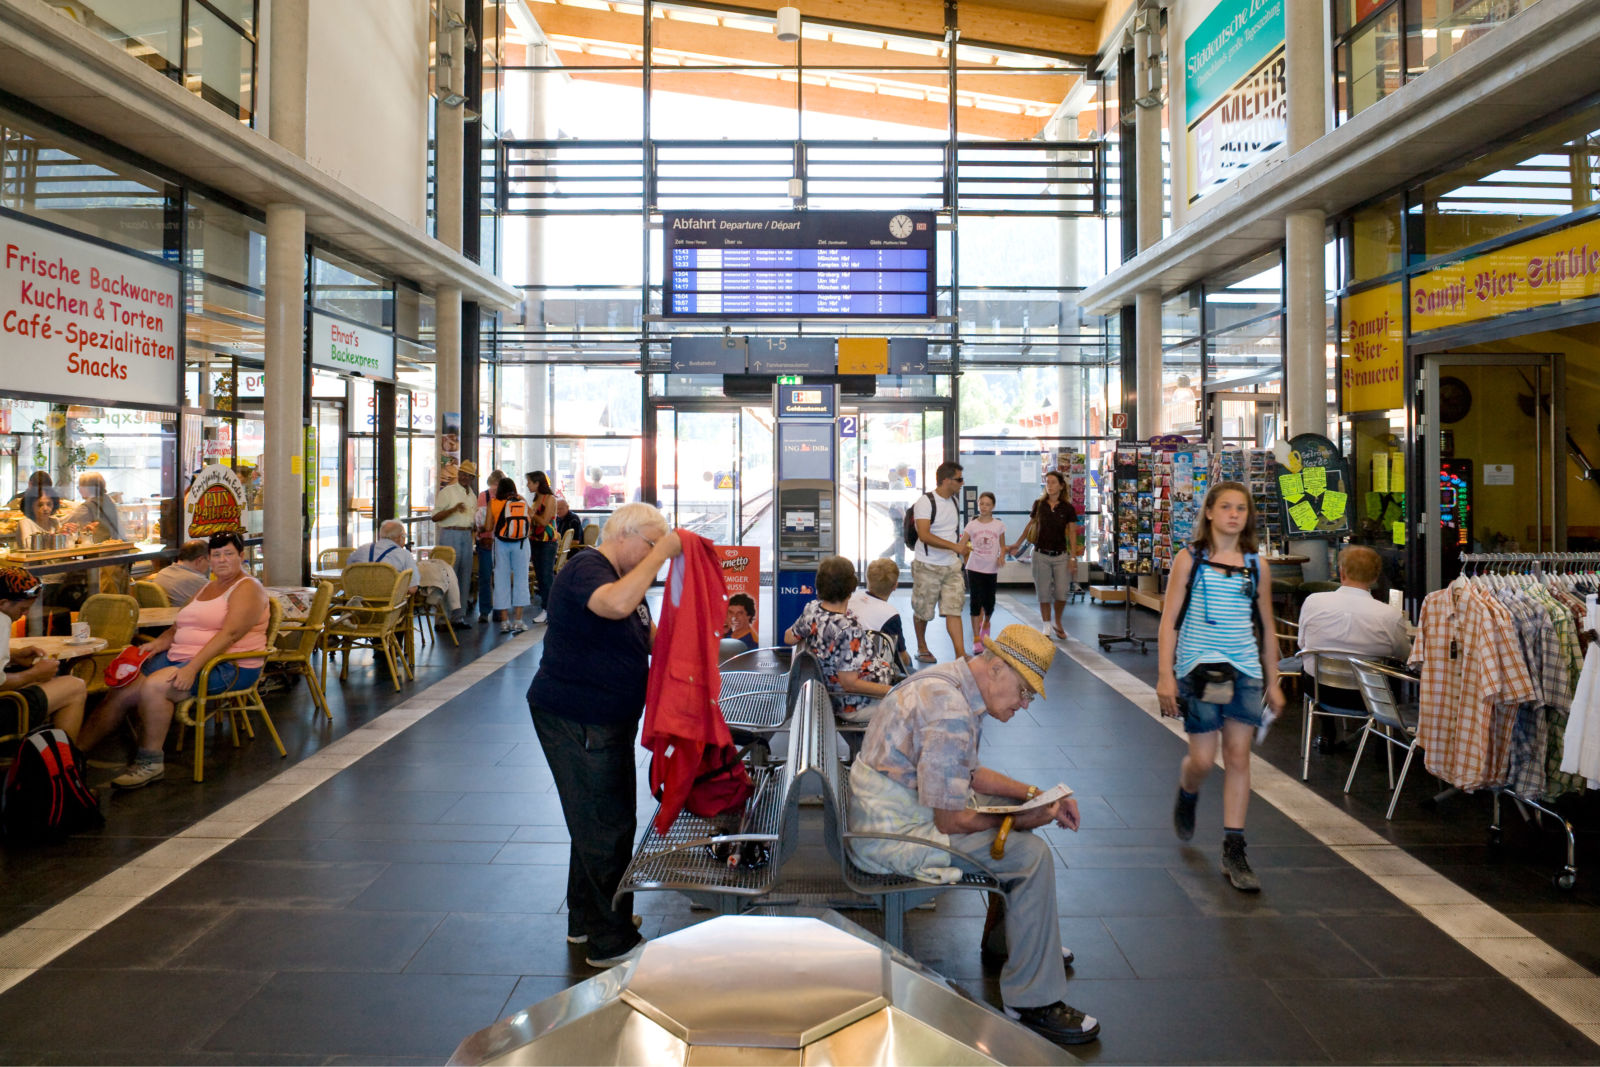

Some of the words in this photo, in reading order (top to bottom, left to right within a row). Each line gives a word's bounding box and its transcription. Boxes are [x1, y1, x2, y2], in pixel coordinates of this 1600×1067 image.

[1221, 57, 1287, 125] MEHR
[672, 218, 717, 230] Abfahrt
[720, 220, 763, 231] Departure
[771, 220, 801, 231] Départ
[6, 244, 81, 285] Frische
[90, 267, 174, 309] Backwaren
[21, 280, 88, 317] Kuchen
[93, 298, 105, 320] &
[109, 301, 163, 332] Torten
[3, 310, 175, 360] Café-Spezialitäten
[767, 338, 787, 351] 1-5
[67, 352, 128, 380] Snacks
[331, 344, 379, 369] Backexpress
[1343, 360, 1400, 389] Brauerei
[843, 417, 854, 434] 2
[204, 491, 230, 507] PAIN
[780, 587, 799, 595] ING
